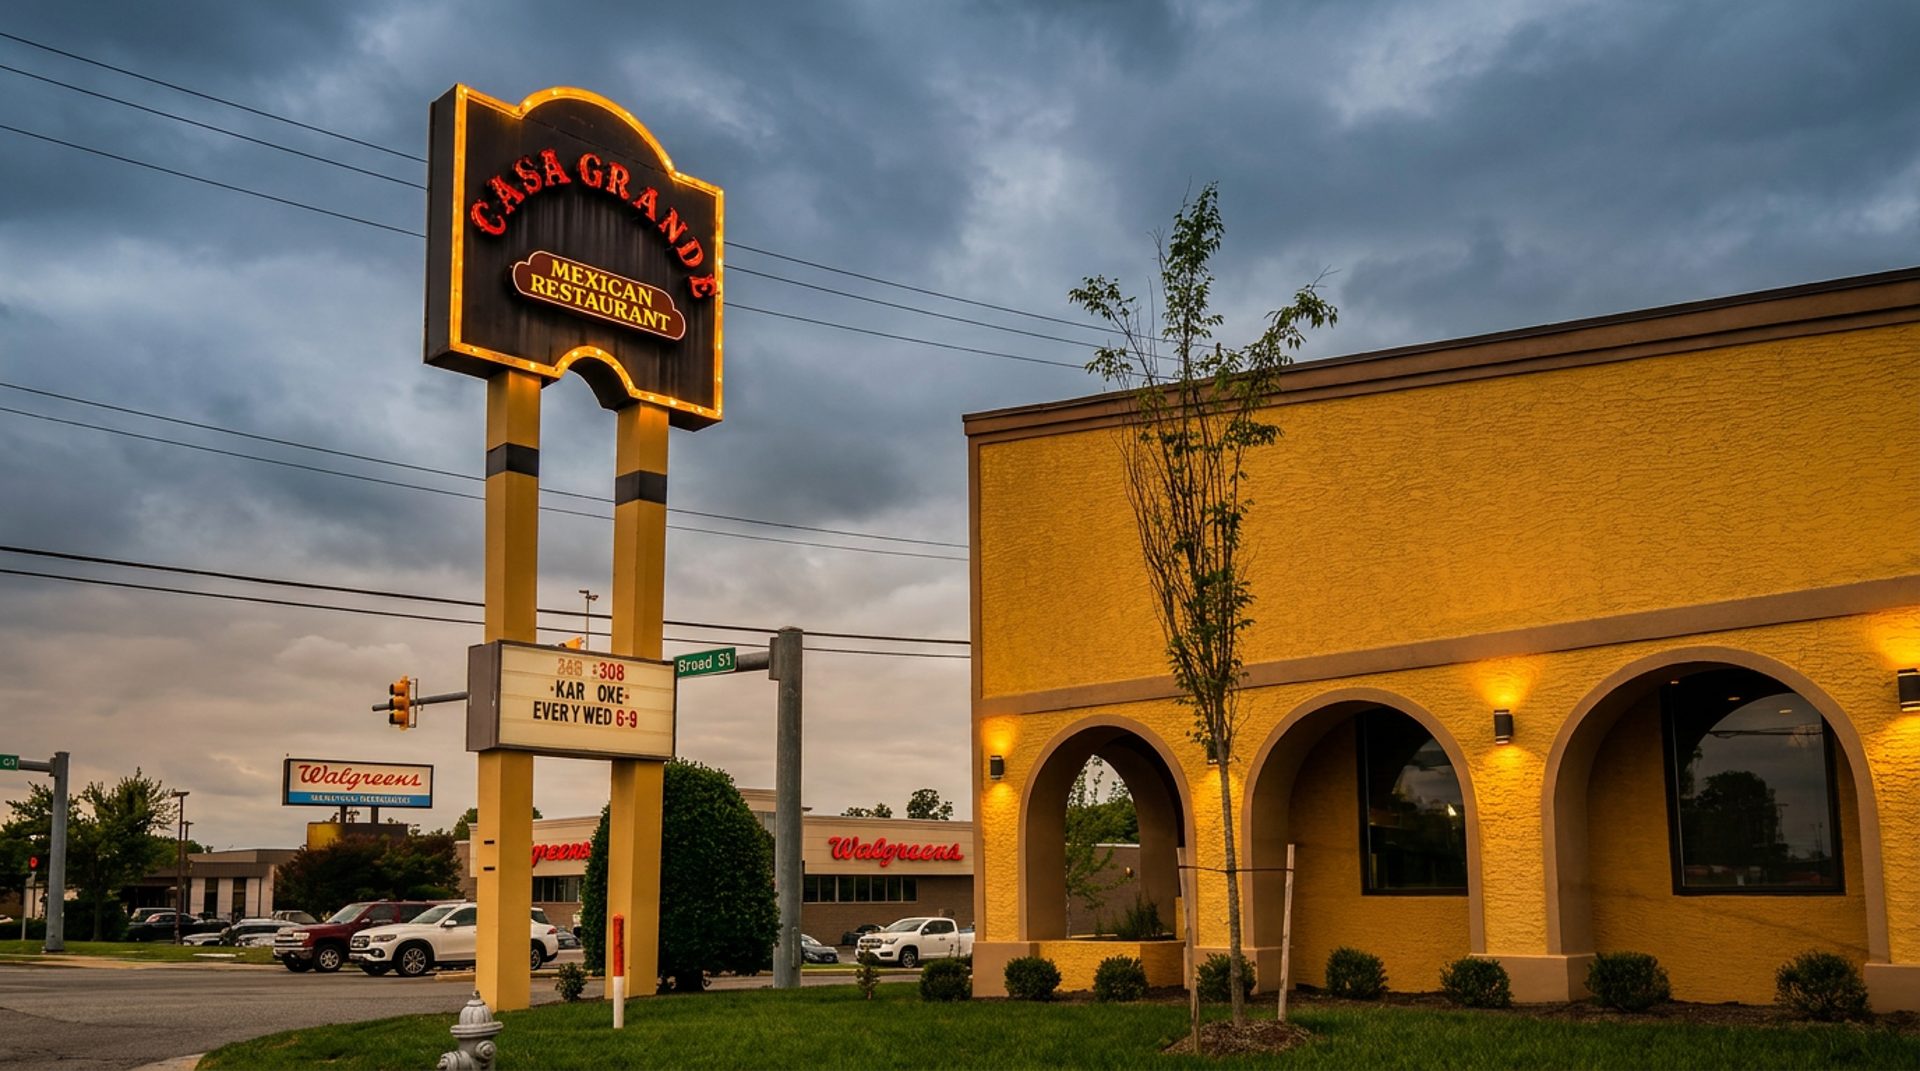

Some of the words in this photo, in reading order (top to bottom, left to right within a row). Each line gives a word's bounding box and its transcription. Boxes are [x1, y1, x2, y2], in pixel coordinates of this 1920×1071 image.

[470, 149, 571, 236] CASA
[577, 152, 719, 298] GRANDE
[551, 259, 652, 307] MEXICAN
[530, 273, 671, 331] RESTAURANT
[678, 655, 713, 673] Broad
[583, 706, 612, 725] WED
[616, 709, 637, 728] 6-9
[298, 764, 422, 791] Walgreens
[828, 836, 965, 868] Walgreens
